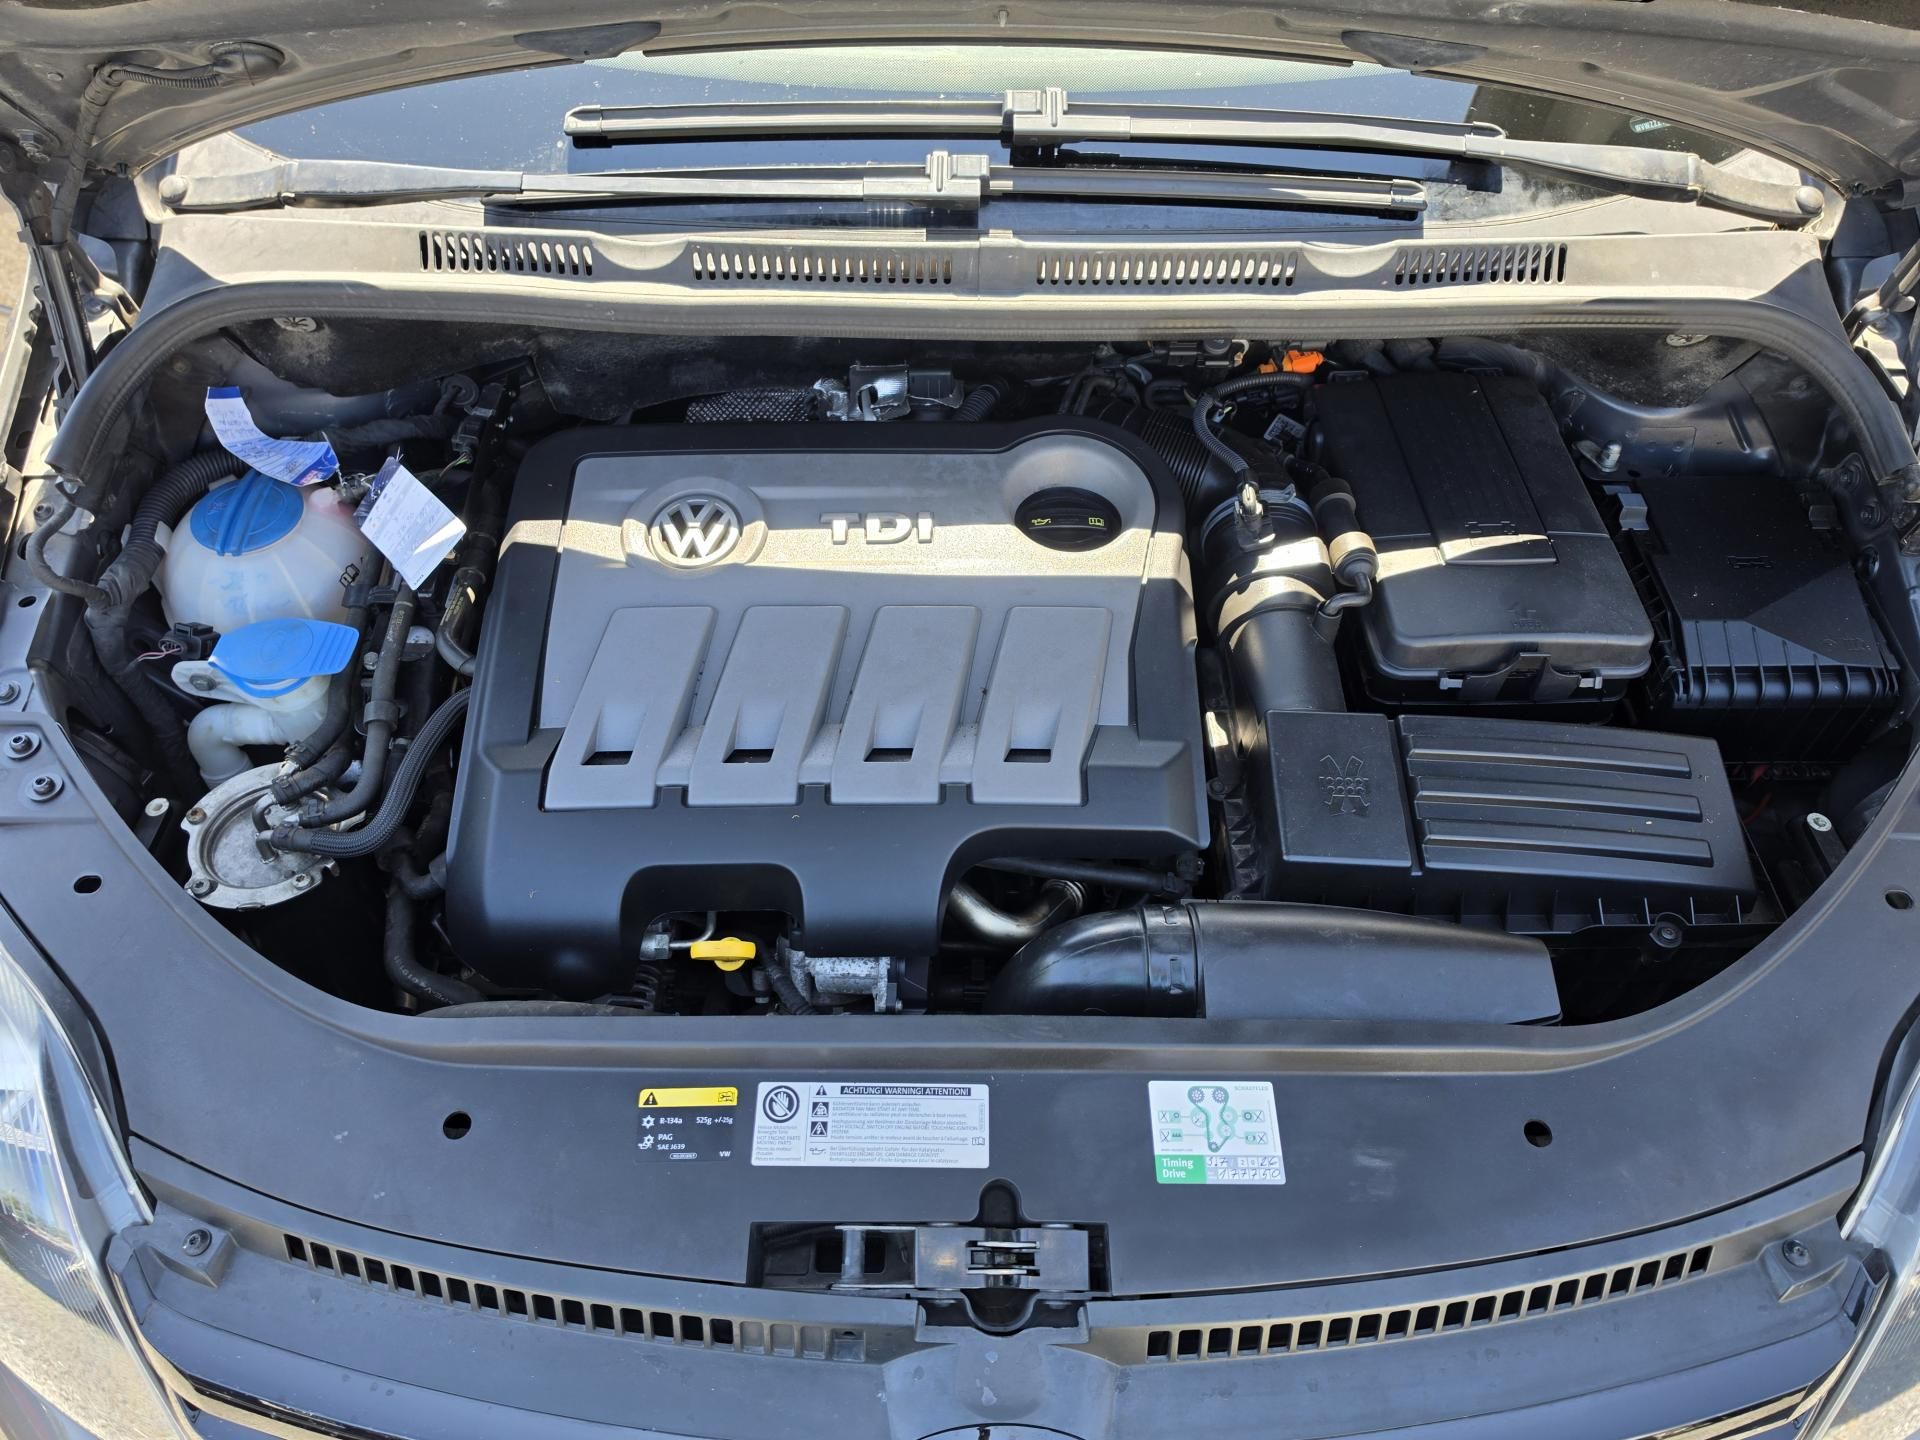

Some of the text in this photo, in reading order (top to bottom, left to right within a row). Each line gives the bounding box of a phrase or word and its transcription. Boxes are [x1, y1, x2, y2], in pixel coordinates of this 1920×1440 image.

[656, 500, 738, 562] VW
[820, 512, 933, 545] TDI
[843, 1086, 968, 1096] ACHTUNG! WARNING! ATTENTION!
[696, 1116, 712, 1125] 525g
[657, 1133, 673, 1141] PAG
[1161, 1158, 1193, 1169] Timing
[1162, 1168, 1186, 1178] Drive
